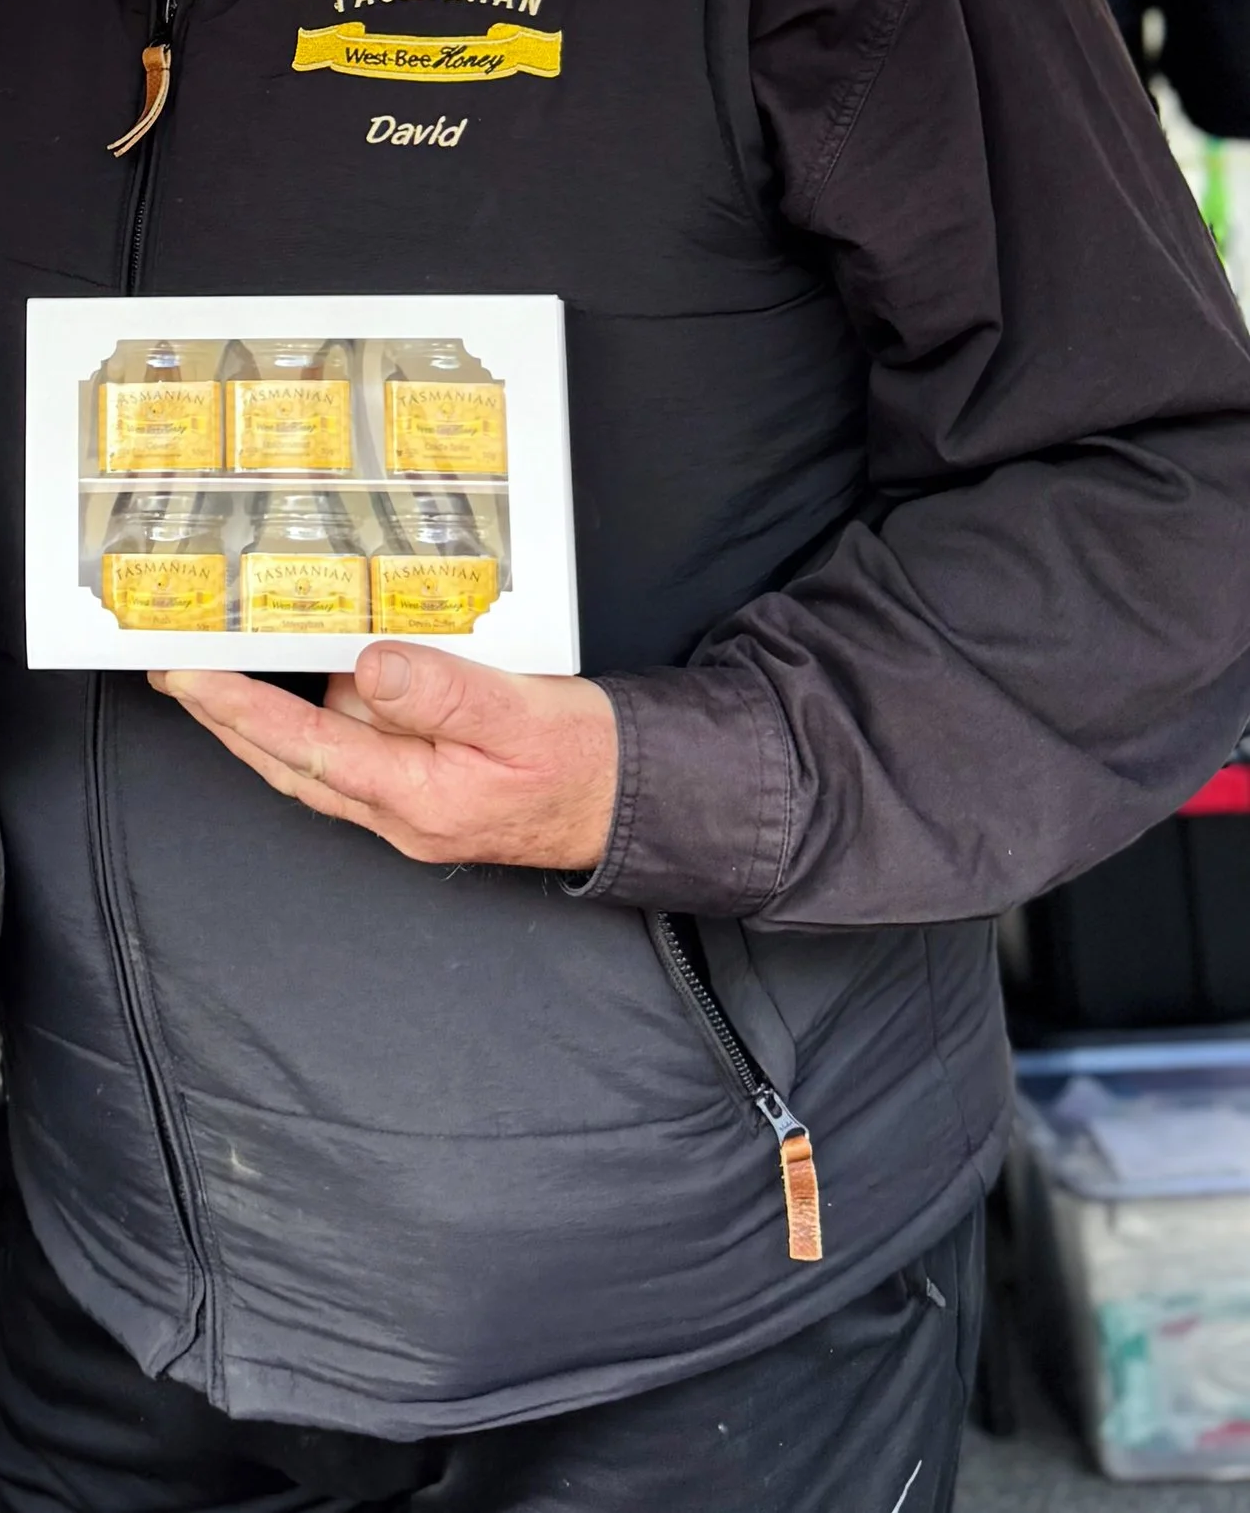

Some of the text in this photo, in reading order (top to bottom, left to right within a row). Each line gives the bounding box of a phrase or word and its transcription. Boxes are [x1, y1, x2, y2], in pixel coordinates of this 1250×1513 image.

[345, 44, 504, 74] West-Bee Honey
[365, 115, 468, 147] David
[116, 390, 205, 407] ASMANIAN
[243, 388, 334, 406] ASMANIAN
[398, 390, 497, 408] TASMANIAN
[116, 561, 211, 582] TASMANIAN
[254, 565, 353, 583] TASMANIAN
[383, 564, 481, 583] TASMANIAN
